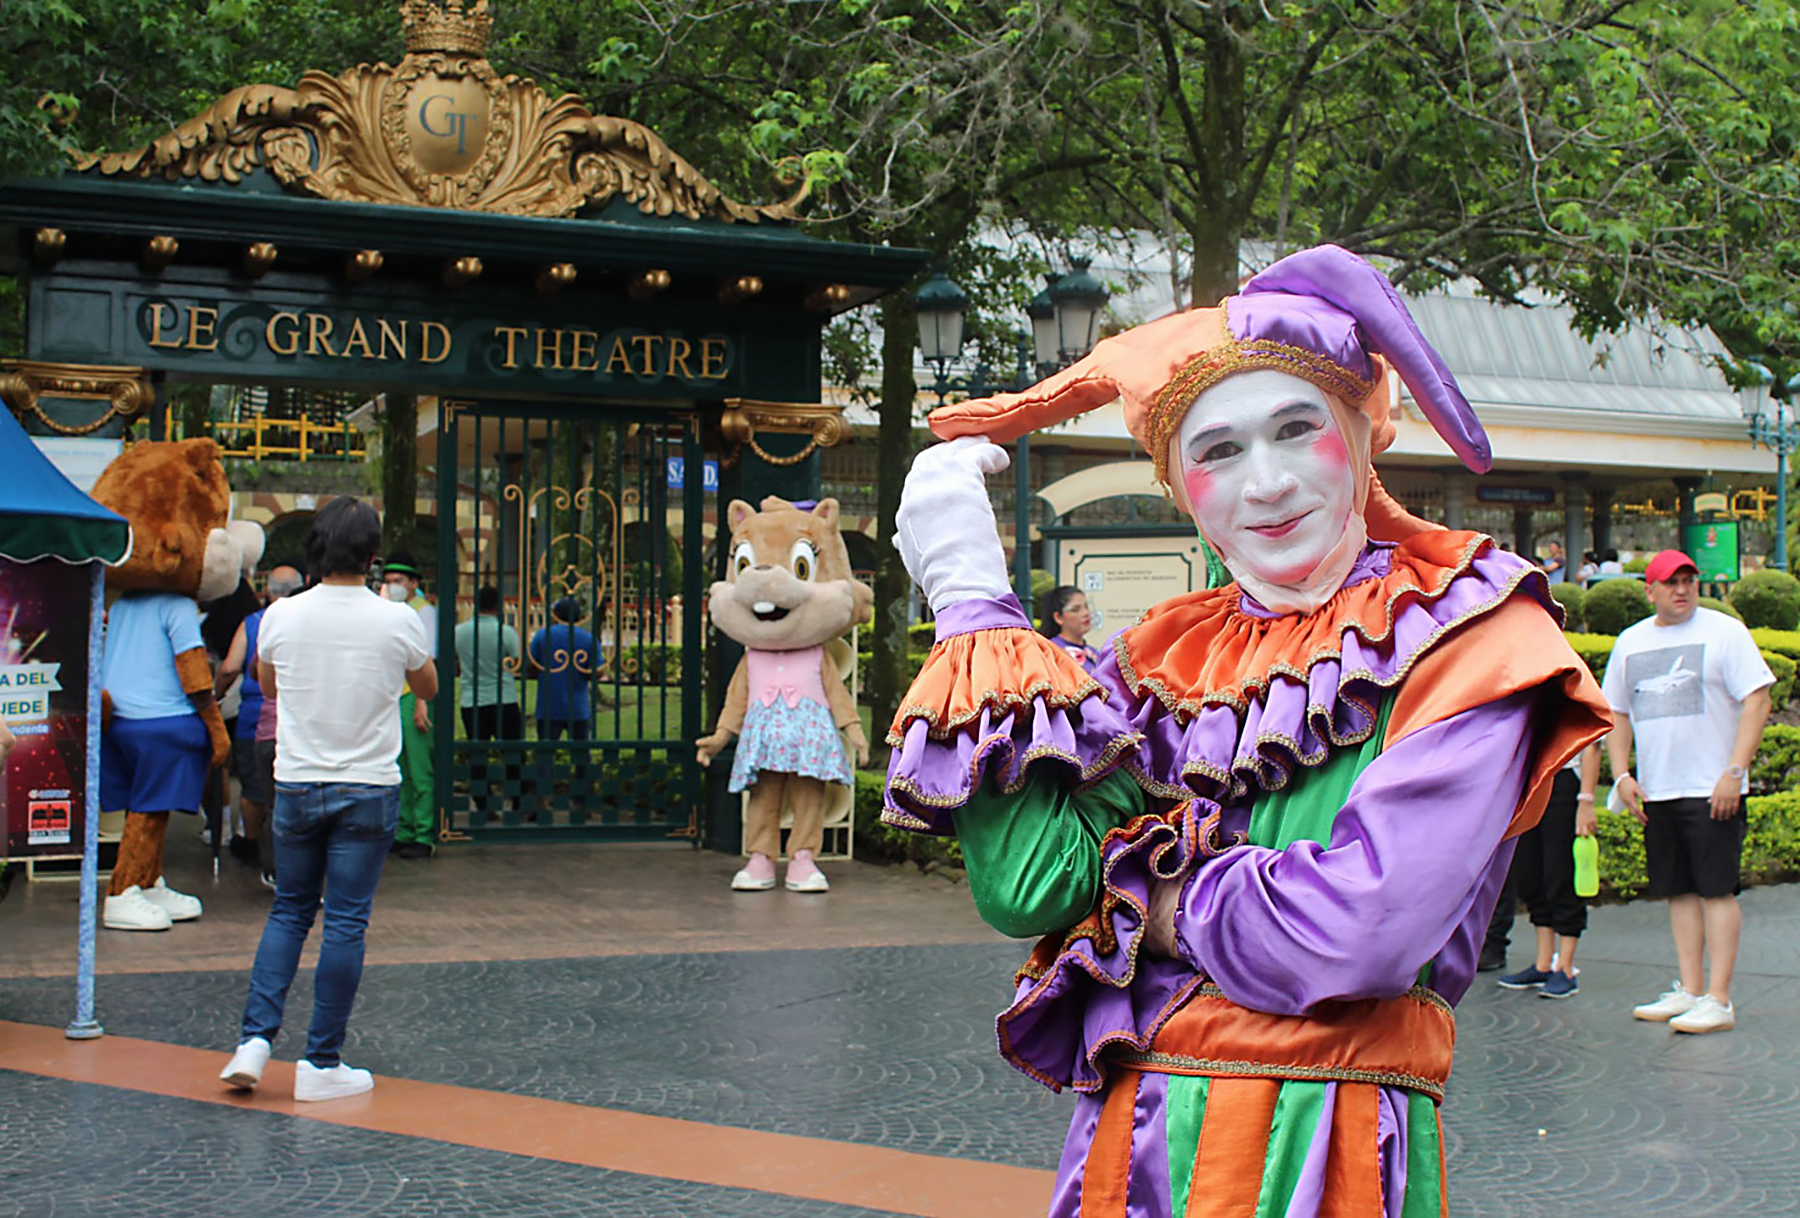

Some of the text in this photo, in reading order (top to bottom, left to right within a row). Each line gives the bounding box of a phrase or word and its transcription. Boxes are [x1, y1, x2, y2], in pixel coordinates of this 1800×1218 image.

[419, 95, 478, 155] GT
[149, 303, 729, 380] LE GRAND THEATRE
[16, 672, 49, 686] DEL
